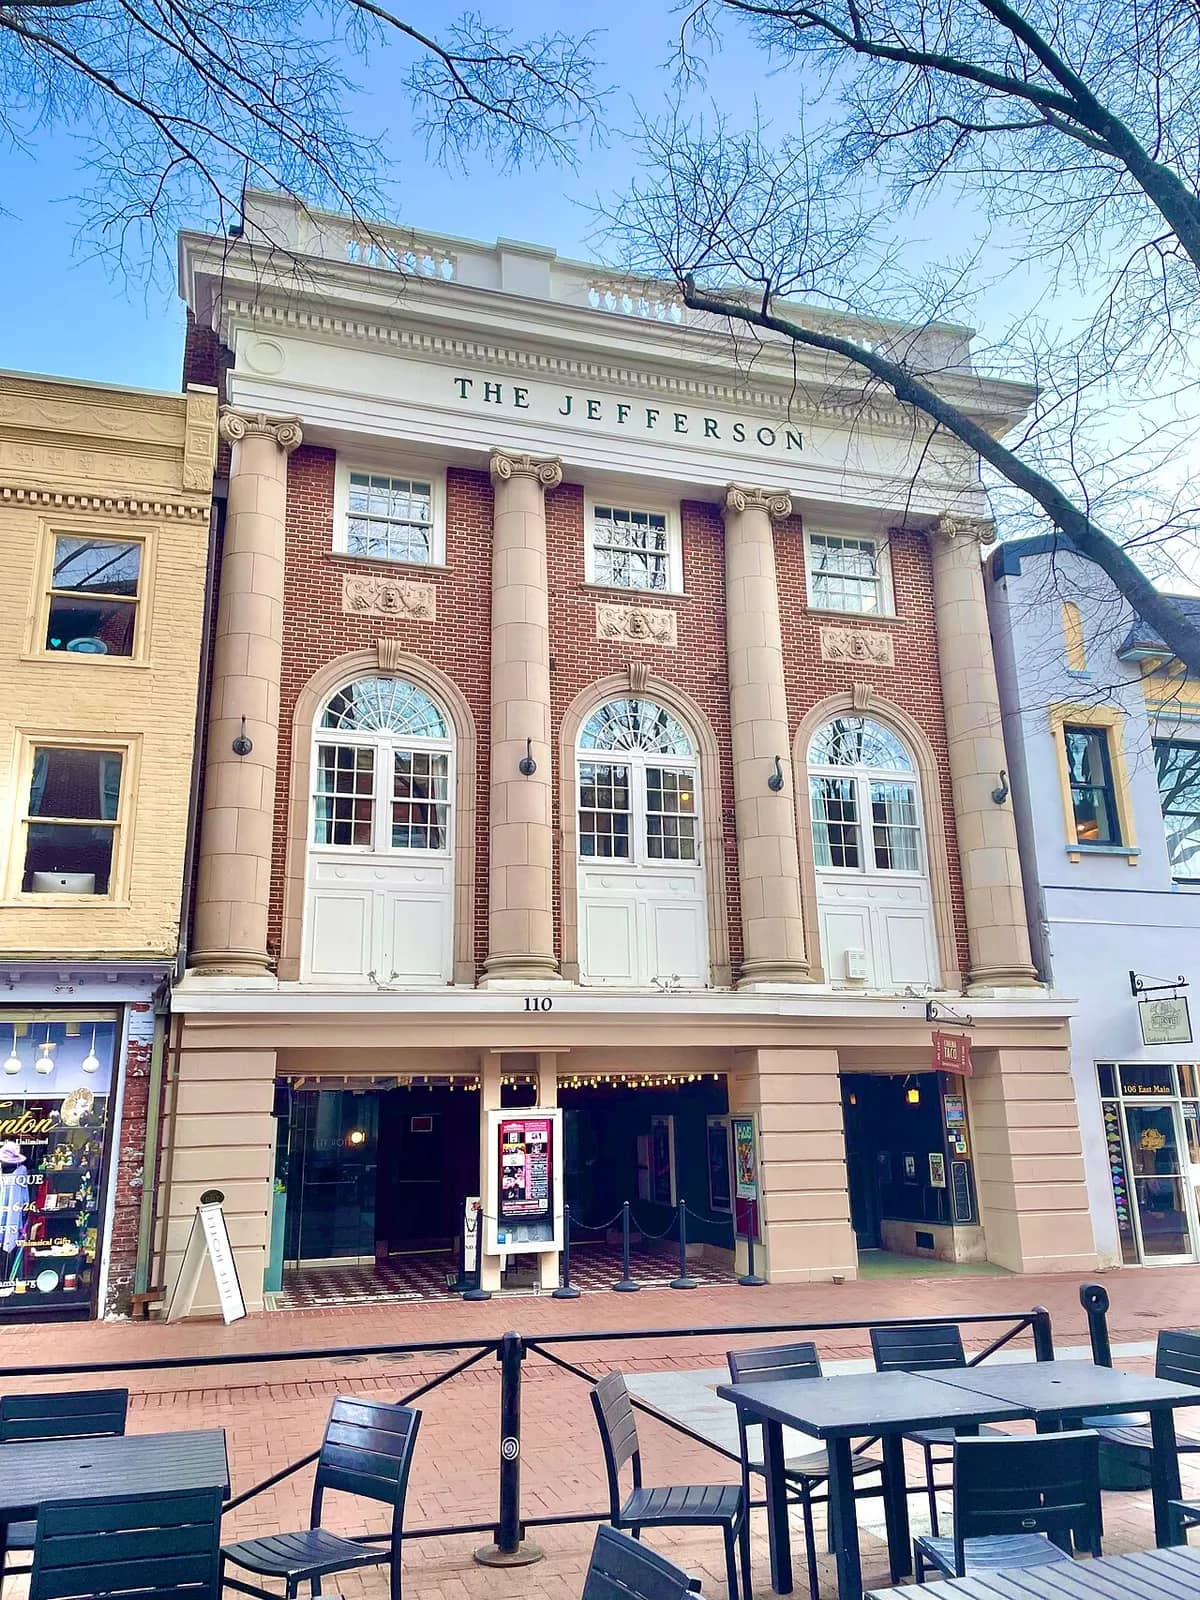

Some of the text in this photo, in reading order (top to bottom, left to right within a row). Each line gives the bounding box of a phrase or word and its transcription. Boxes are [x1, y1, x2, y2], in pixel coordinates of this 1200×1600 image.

[454, 378, 804, 451] THE JEFFERSON
[523, 997, 553, 1011] 110
[944, 1047, 958, 1060] TACO
[1123, 1085, 1170, 1093] 106 East Main
[0, 1111, 59, 1134] nton
[15, 1238, 52, 1247] Whimsical
